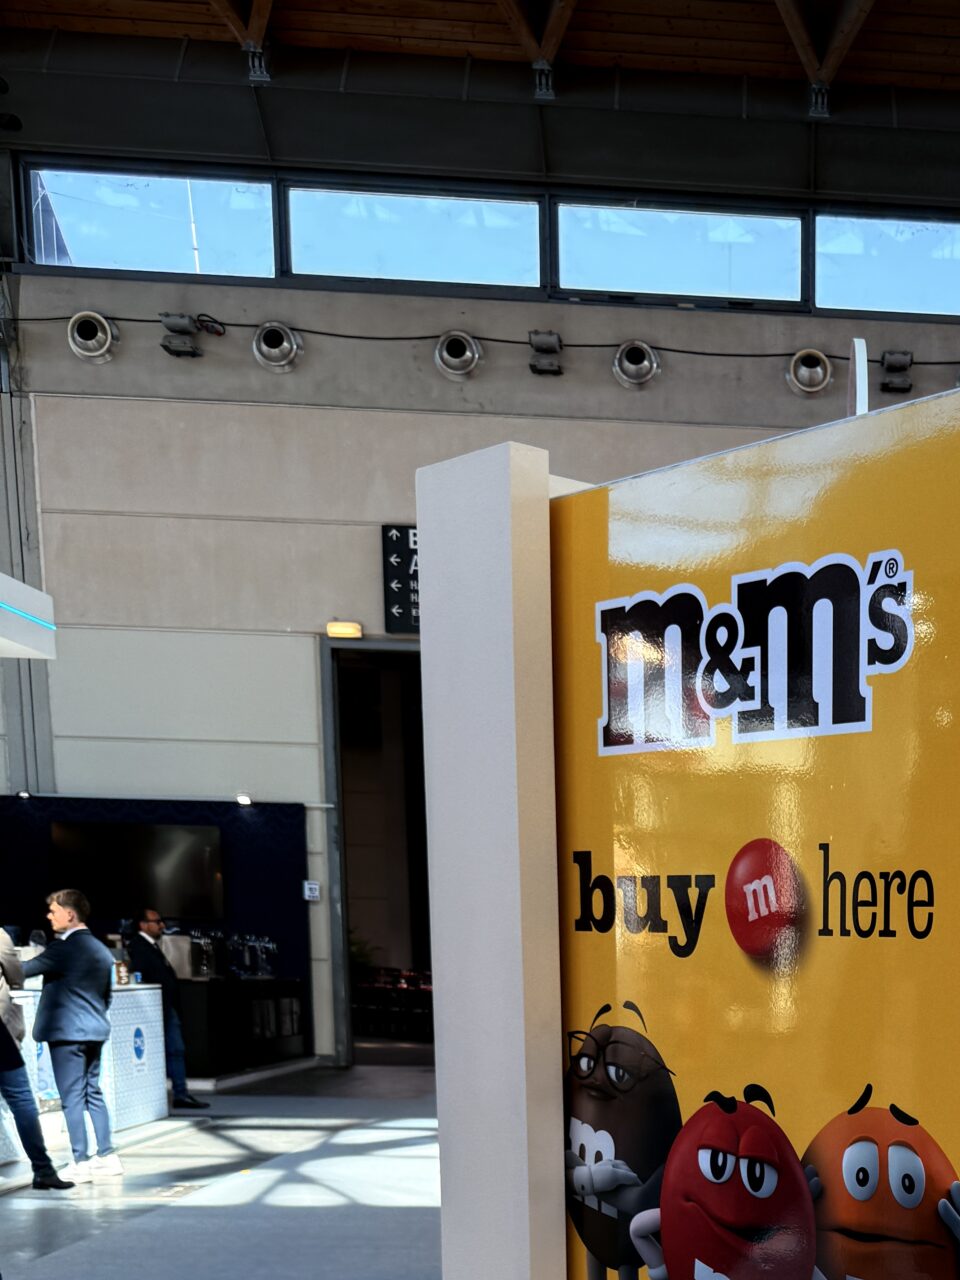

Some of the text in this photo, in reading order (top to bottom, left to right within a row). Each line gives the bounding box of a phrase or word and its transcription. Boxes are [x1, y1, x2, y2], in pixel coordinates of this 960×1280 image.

[573, 843, 935, 958] buy m here
